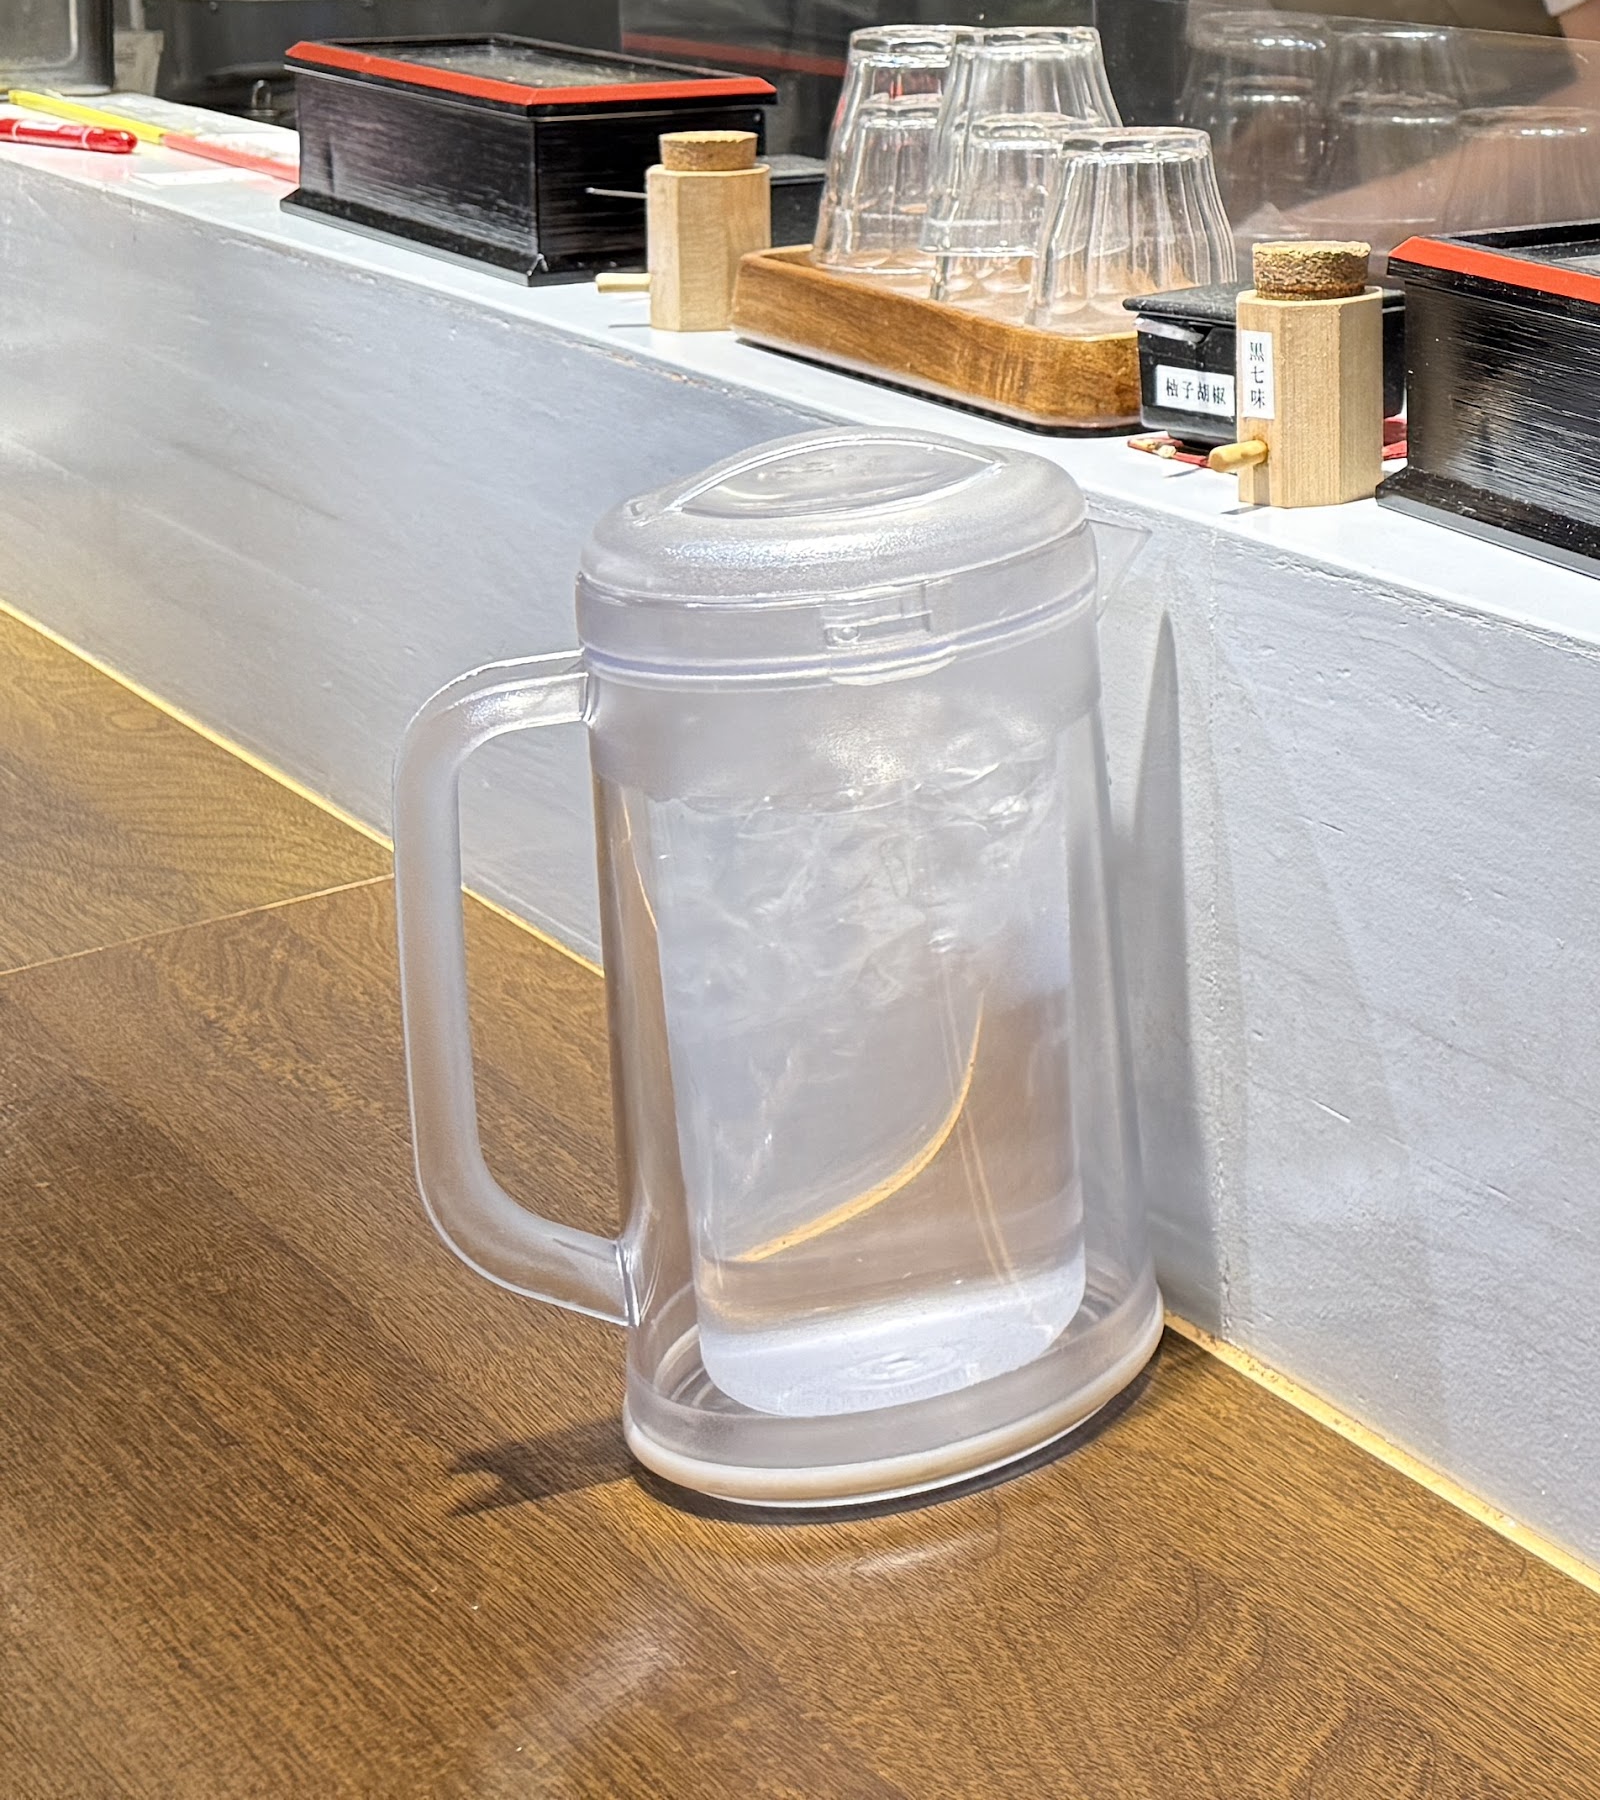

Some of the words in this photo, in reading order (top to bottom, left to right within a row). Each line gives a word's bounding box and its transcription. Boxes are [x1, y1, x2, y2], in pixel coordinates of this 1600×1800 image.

[1166, 377, 1226, 405] 柚子胡椒
[1250, 342, 1265, 409] 黒七味
